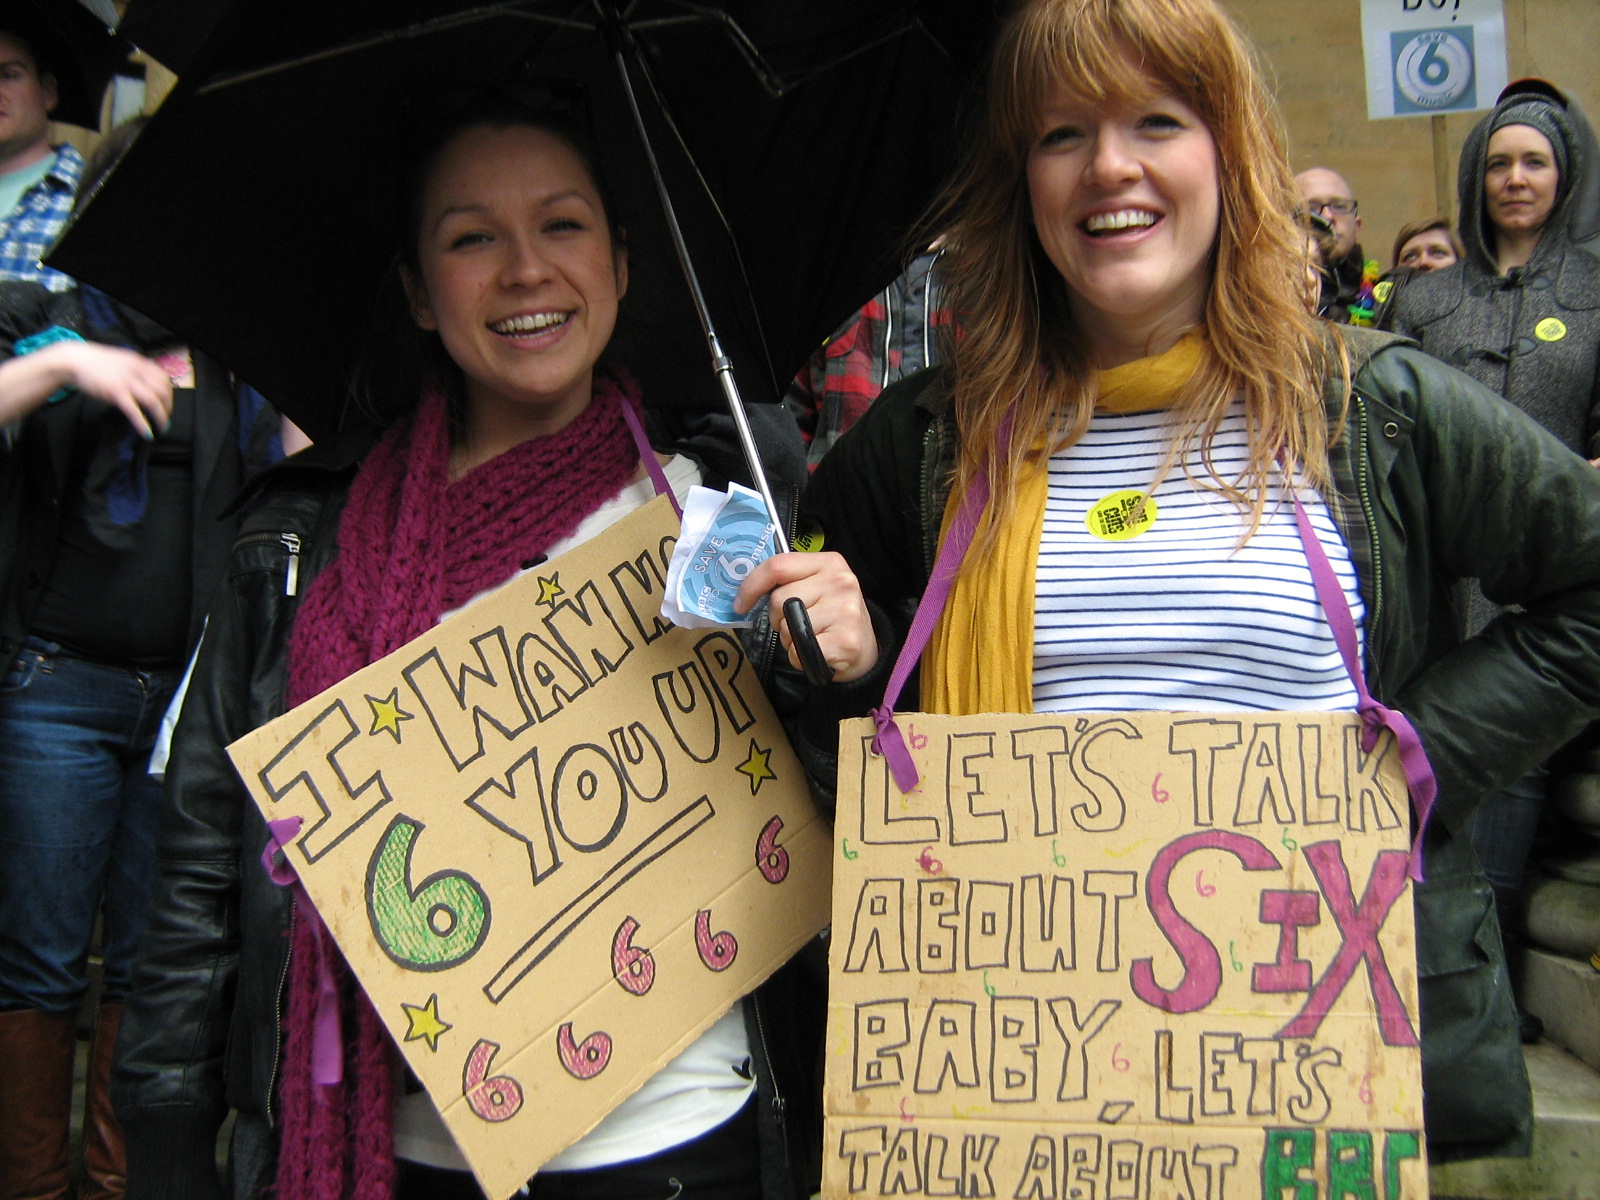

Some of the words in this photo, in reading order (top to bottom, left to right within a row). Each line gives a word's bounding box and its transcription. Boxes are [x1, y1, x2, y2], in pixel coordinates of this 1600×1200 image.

[1418, 41, 1450, 86] 6
[695, 536, 724, 573] SAVE
[750, 522, 776, 561] music
[908, 724, 928, 750] 6
[258, 698, 393, 864] I
[366, 814, 492, 972] 6
[465, 721, 667, 886] YOU
[652, 631, 756, 764] UP
[860, 718, 1142, 846] LET'S
[1169, 718, 1401, 832] TALK
[1151, 773, 1170, 803] 6
[756, 814, 790, 884] 6
[1052, 839, 1066, 867] 6
[1281, 827, 1297, 851] 6
[1195, 870, 1216, 897] 6
[611, 915, 656, 996] 6
[694, 909, 738, 972] 6
[843, 870, 1138, 973] ABOUT
[1129, 828, 1421, 1047] SIX
[463, 1038, 524, 1122] 6
[557, 1021, 613, 1080] 6
[1111, 1042, 1131, 1073] 6
[1154, 1030, 1342, 1124] LET'S
[839, 1125, 1000, 1199] TALK
[1013, 1133, 1239, 1200] ABOUT
